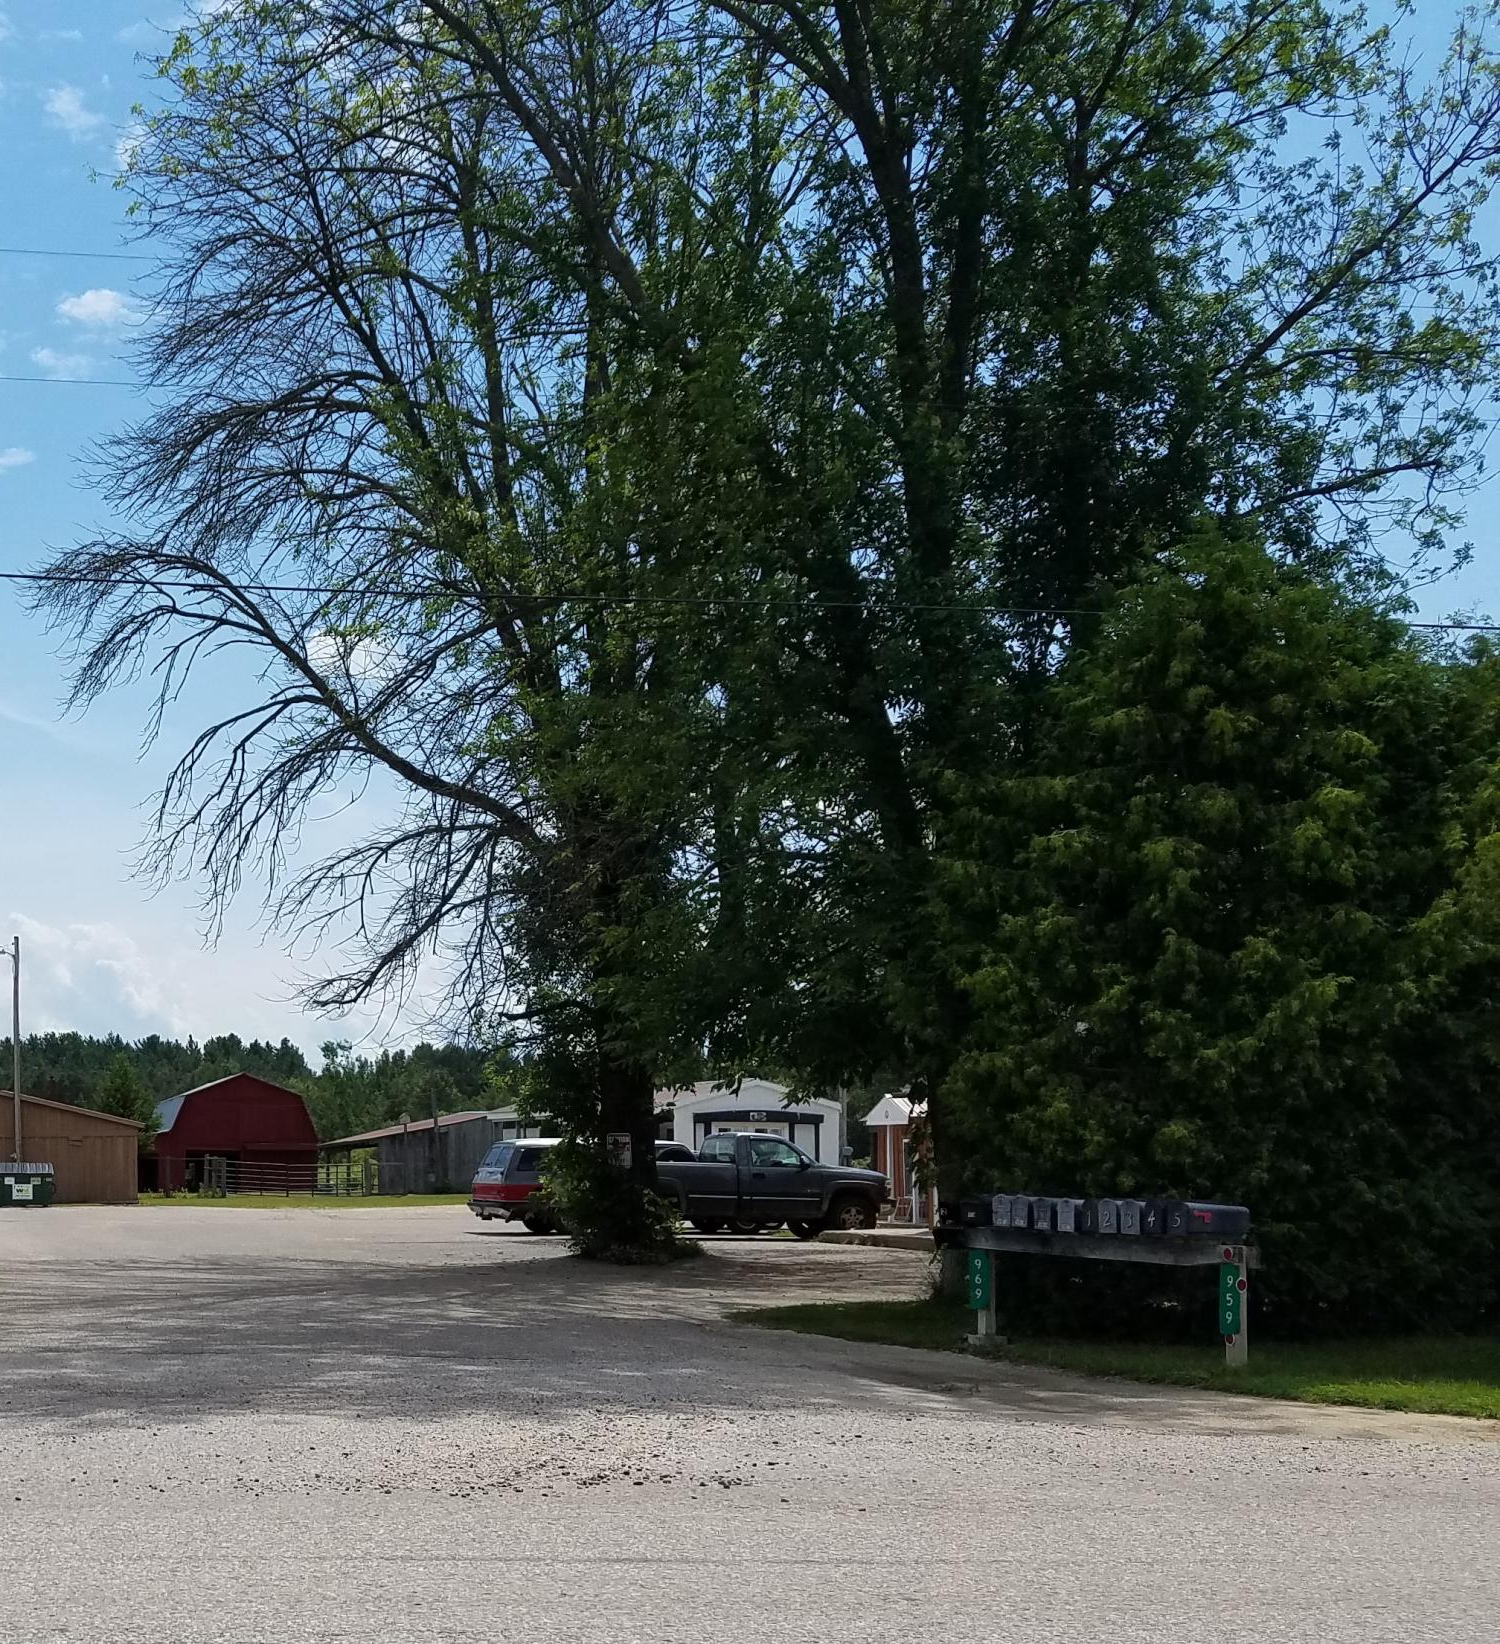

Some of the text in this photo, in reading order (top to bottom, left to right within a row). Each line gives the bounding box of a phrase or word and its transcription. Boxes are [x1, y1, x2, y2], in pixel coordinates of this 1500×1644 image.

[1086, 1210, 1092, 1228] 1
[1102, 1211, 1112, 1227] 2
[1126, 1211, 1135, 1229] 3
[1147, 1209, 1156, 1228] 4
[1171, 1212, 1181, 1228] 5
[974, 1258, 983, 1300] 969
[1225, 1275, 1235, 1325] 959
